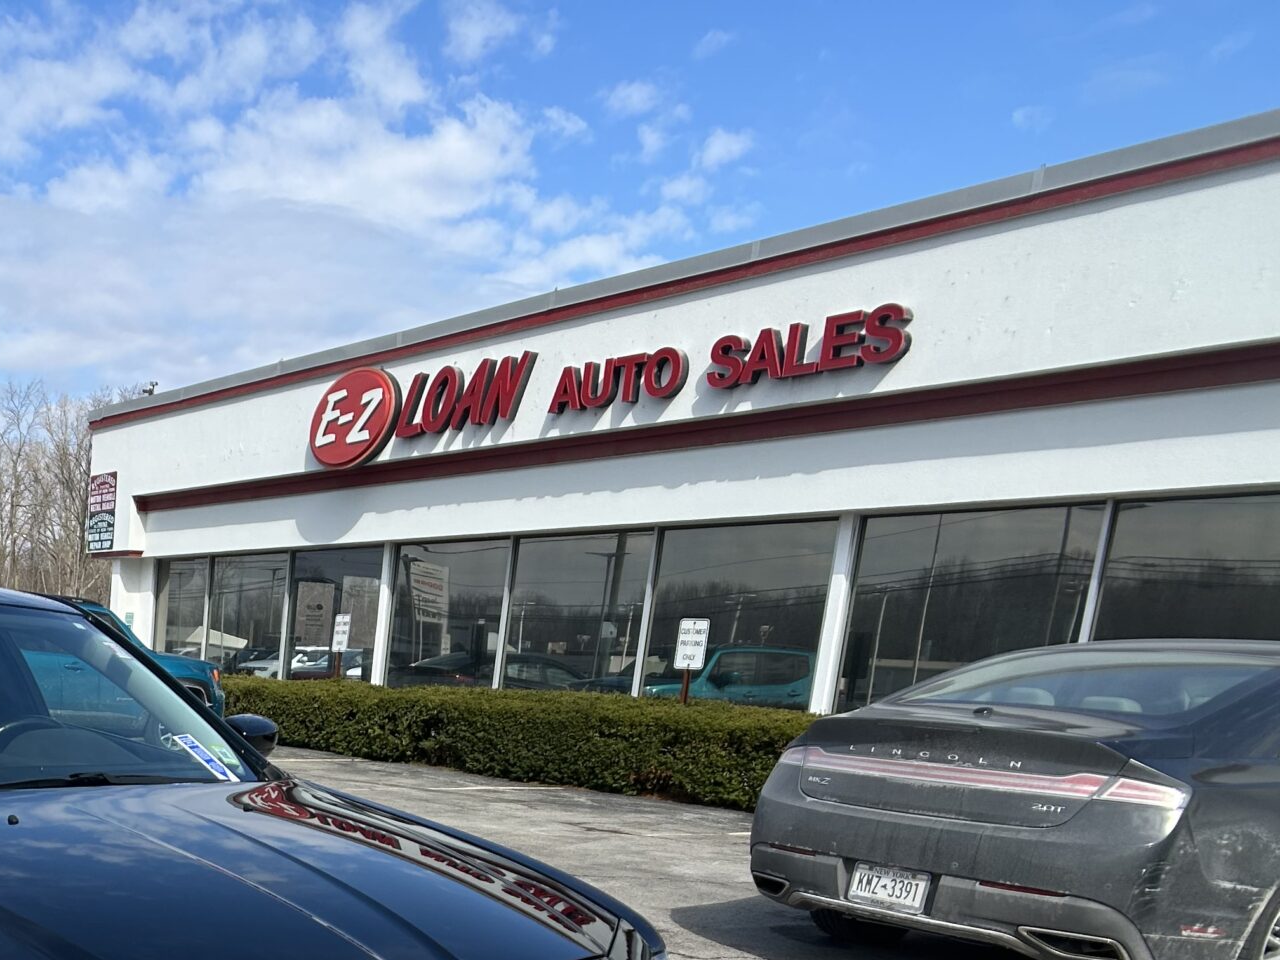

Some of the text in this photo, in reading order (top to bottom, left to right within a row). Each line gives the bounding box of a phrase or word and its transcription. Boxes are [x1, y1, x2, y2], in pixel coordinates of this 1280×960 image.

[314, 302, 913, 449] E-Z LOAN AUTO SALES
[680, 639, 703, 647] PARKING
[849, 744, 1022, 769] LINCOLN
[874, 867, 914, 880] NEW YORK
